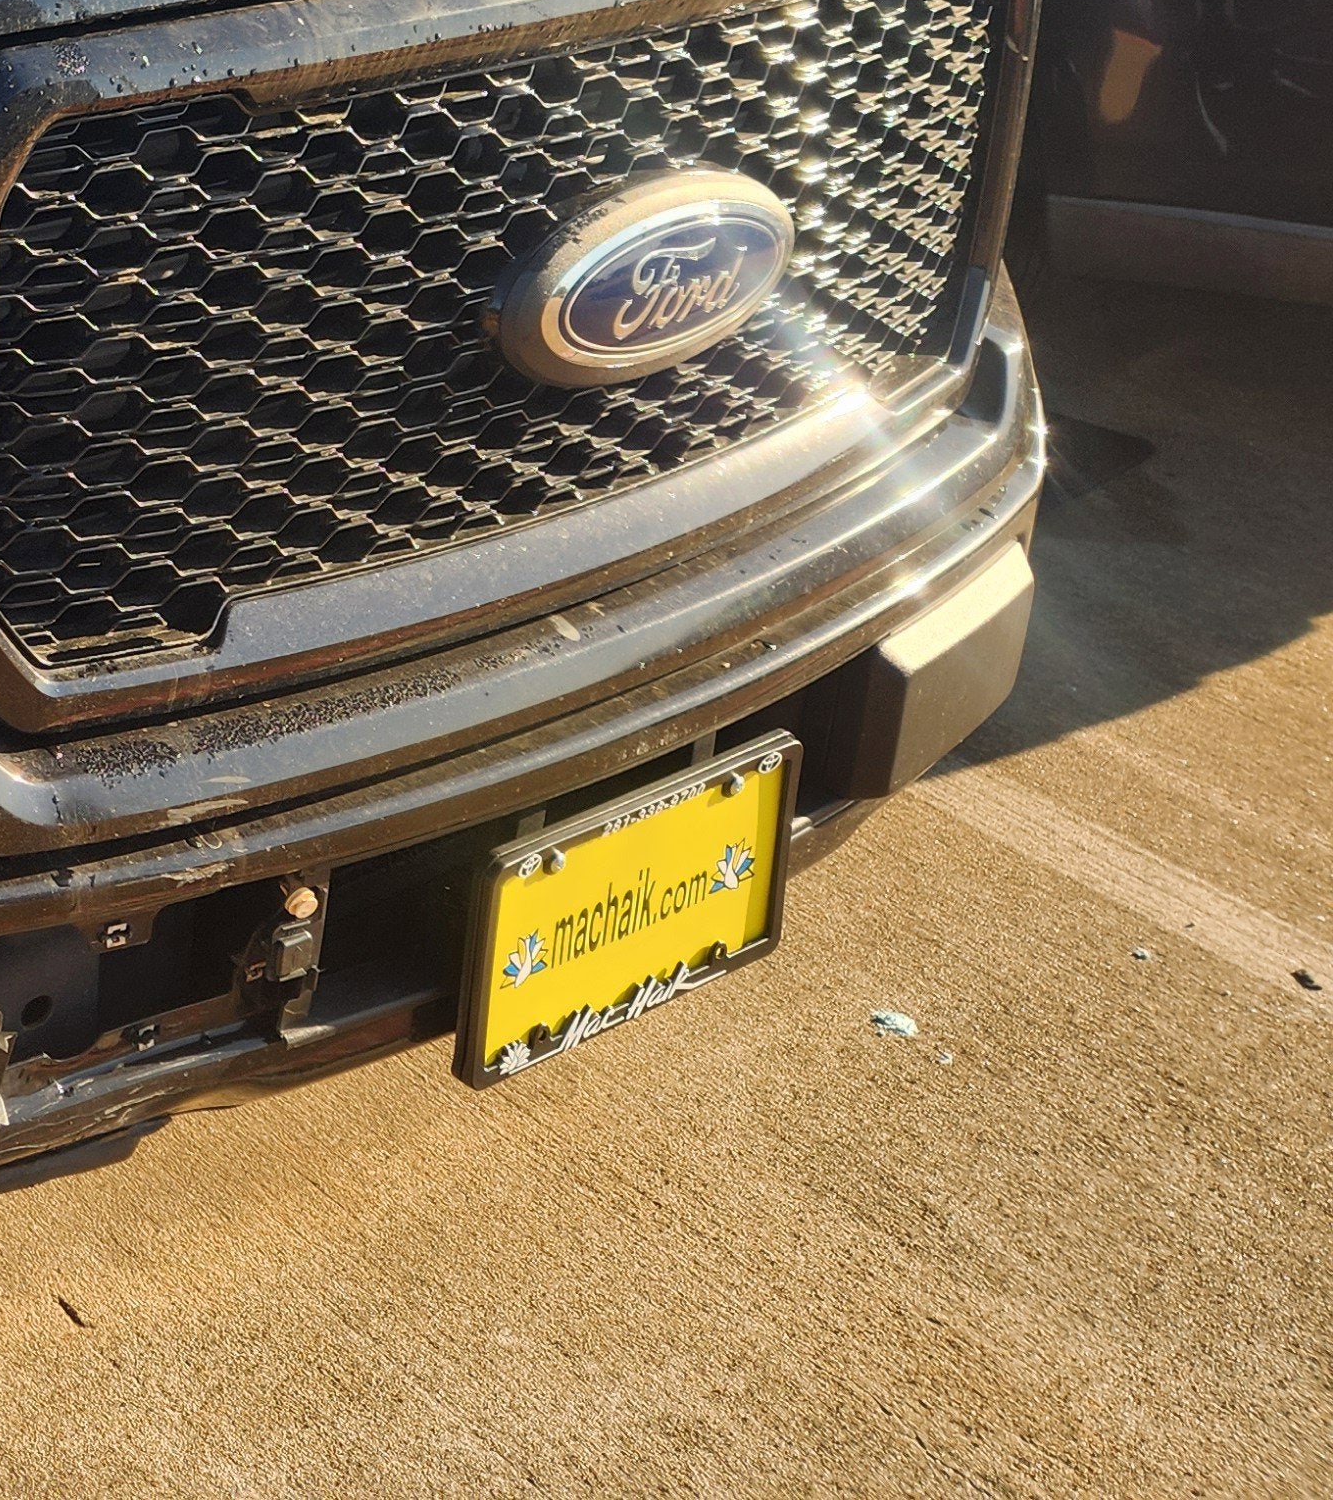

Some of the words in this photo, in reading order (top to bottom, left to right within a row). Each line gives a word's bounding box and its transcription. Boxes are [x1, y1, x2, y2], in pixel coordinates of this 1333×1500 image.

[612, 238, 748, 340] Ford
[550, 866, 708, 969] machaik.com
[561, 1003, 629, 1051] Mac
[626, 961, 701, 1019] Haik
